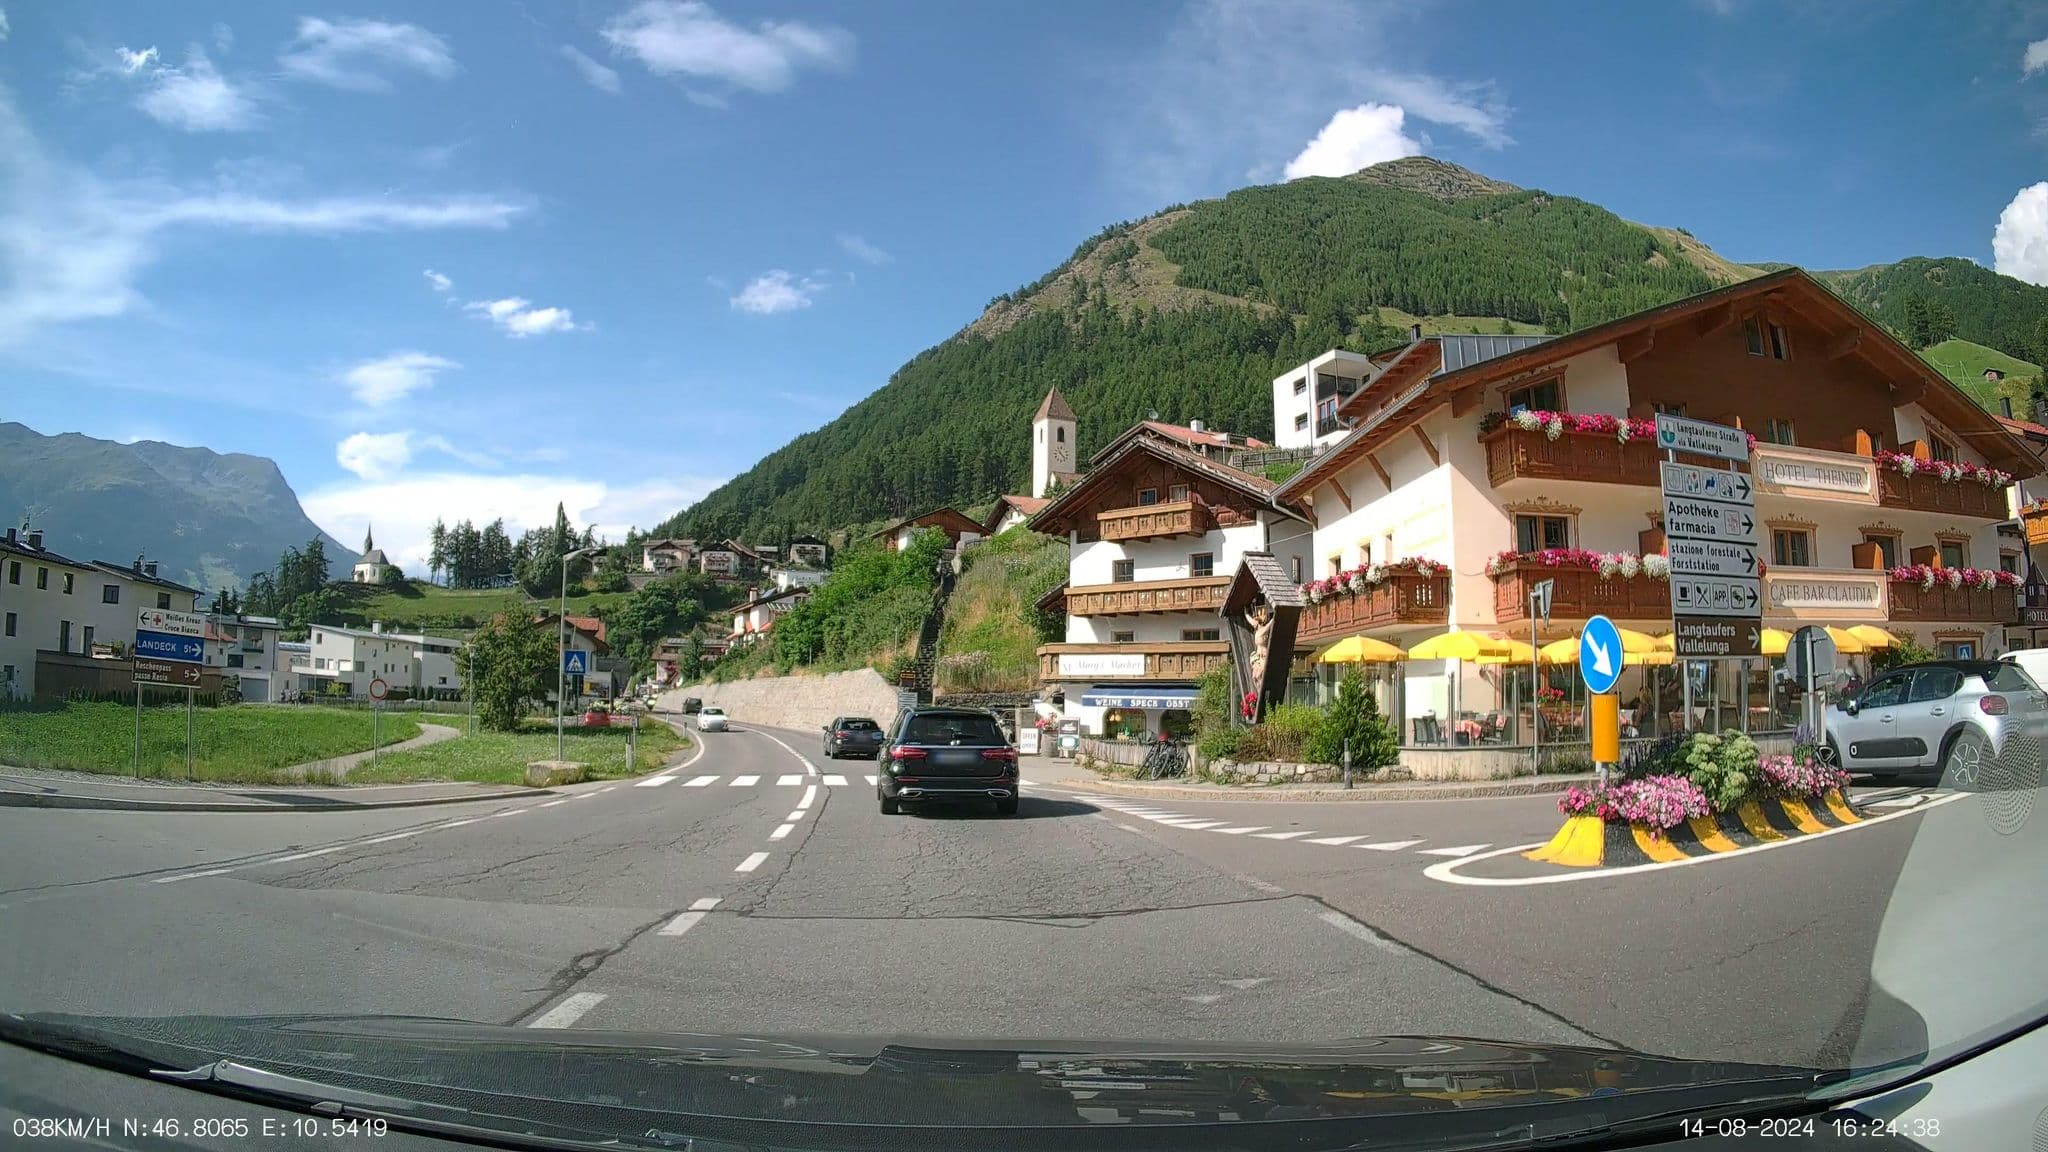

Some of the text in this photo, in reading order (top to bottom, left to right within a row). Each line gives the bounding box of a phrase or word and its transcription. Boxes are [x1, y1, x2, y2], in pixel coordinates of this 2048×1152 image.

[1678, 437, 1722, 455] via Vallelunga
[1764, 462, 1863, 487] HOTEL THEINER
[1668, 501, 1719, 518] Apotheke
[1669, 519, 1716, 535] farmacia
[1672, 543, 1741, 558] stazione forestale
[1672, 558, 1720, 571] Forststation
[1714, 590, 1727, 602] APP
[1803, 585, 1825, 601] BAR
[1828, 586, 1873, 602] CLAUDIA
[2026, 611, 2048, 621] HOTEL
[164, 623, 199, 634] Croce Bianca
[1678, 622, 1736, 638] Langtaufers
[137, 639, 191, 653] LANDECK 51
[1678, 639, 1730, 654] Vallelunga
[184, 670, 190, 678] 5
[1095, 698, 1190, 708] WEINE SPECK OBST
